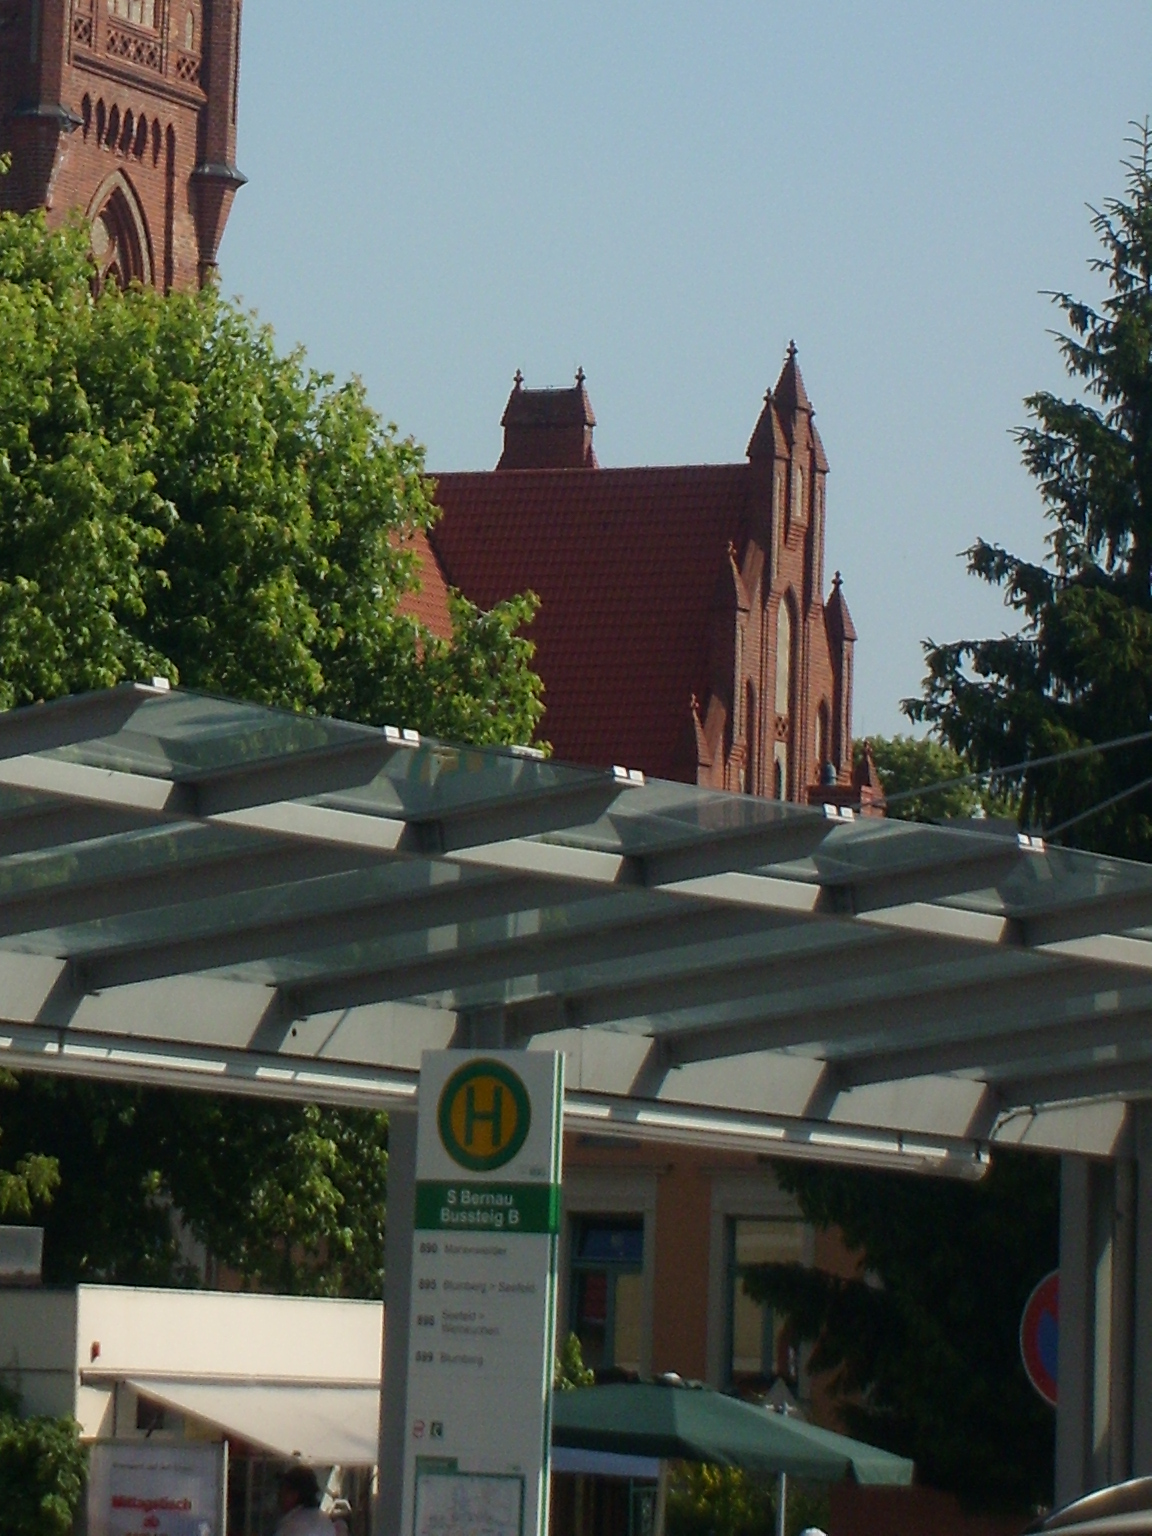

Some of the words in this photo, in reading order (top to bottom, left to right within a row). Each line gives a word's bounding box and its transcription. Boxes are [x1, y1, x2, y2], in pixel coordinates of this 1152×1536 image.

[464, 1085, 503, 1147] H
[447, 1188, 457, 1204] S
[461, 1189, 513, 1206] Bernau
[440, 1207, 504, 1227] Bussteig
[508, 1208, 520, 1224] B
